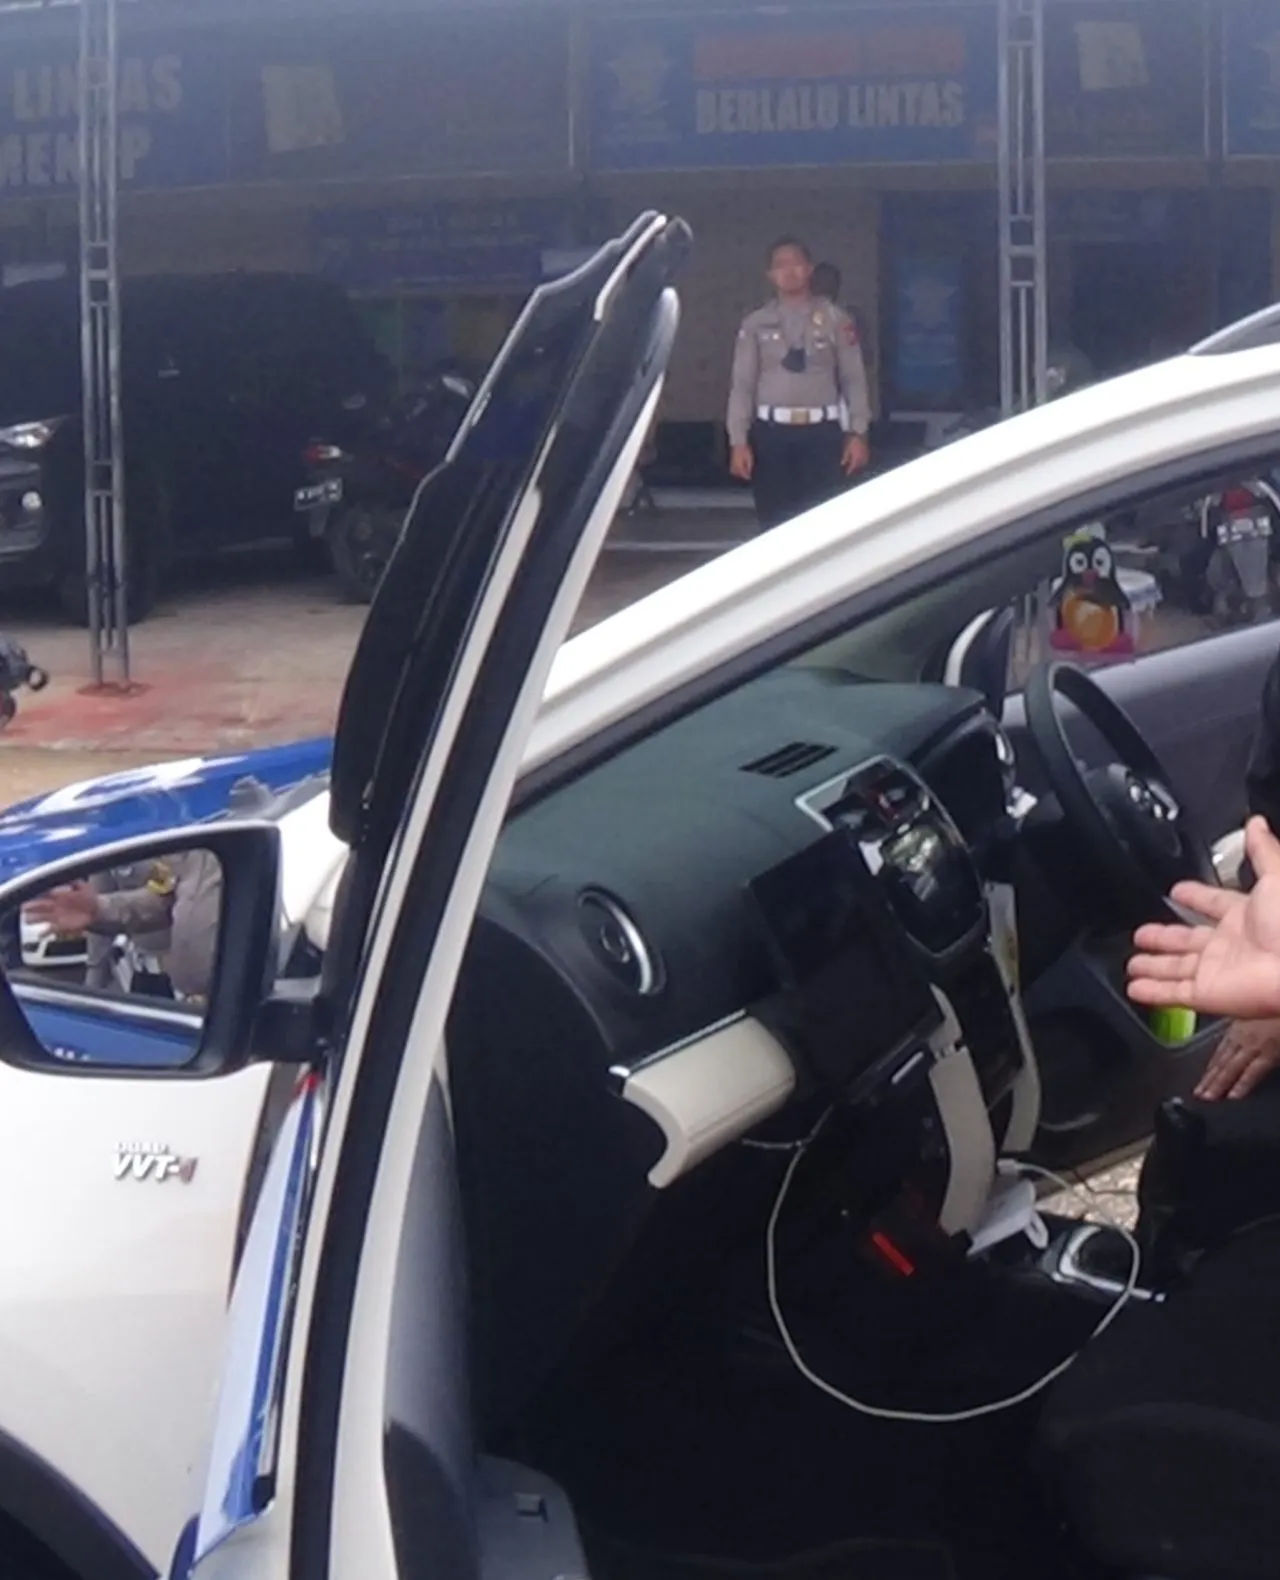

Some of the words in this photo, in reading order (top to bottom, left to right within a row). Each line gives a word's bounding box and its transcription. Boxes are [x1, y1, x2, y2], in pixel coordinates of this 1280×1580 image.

[13, 54, 184, 121] LINAS
[696, 84, 838, 135] BERLALU
[848, 80, 965, 128] LINTAS
